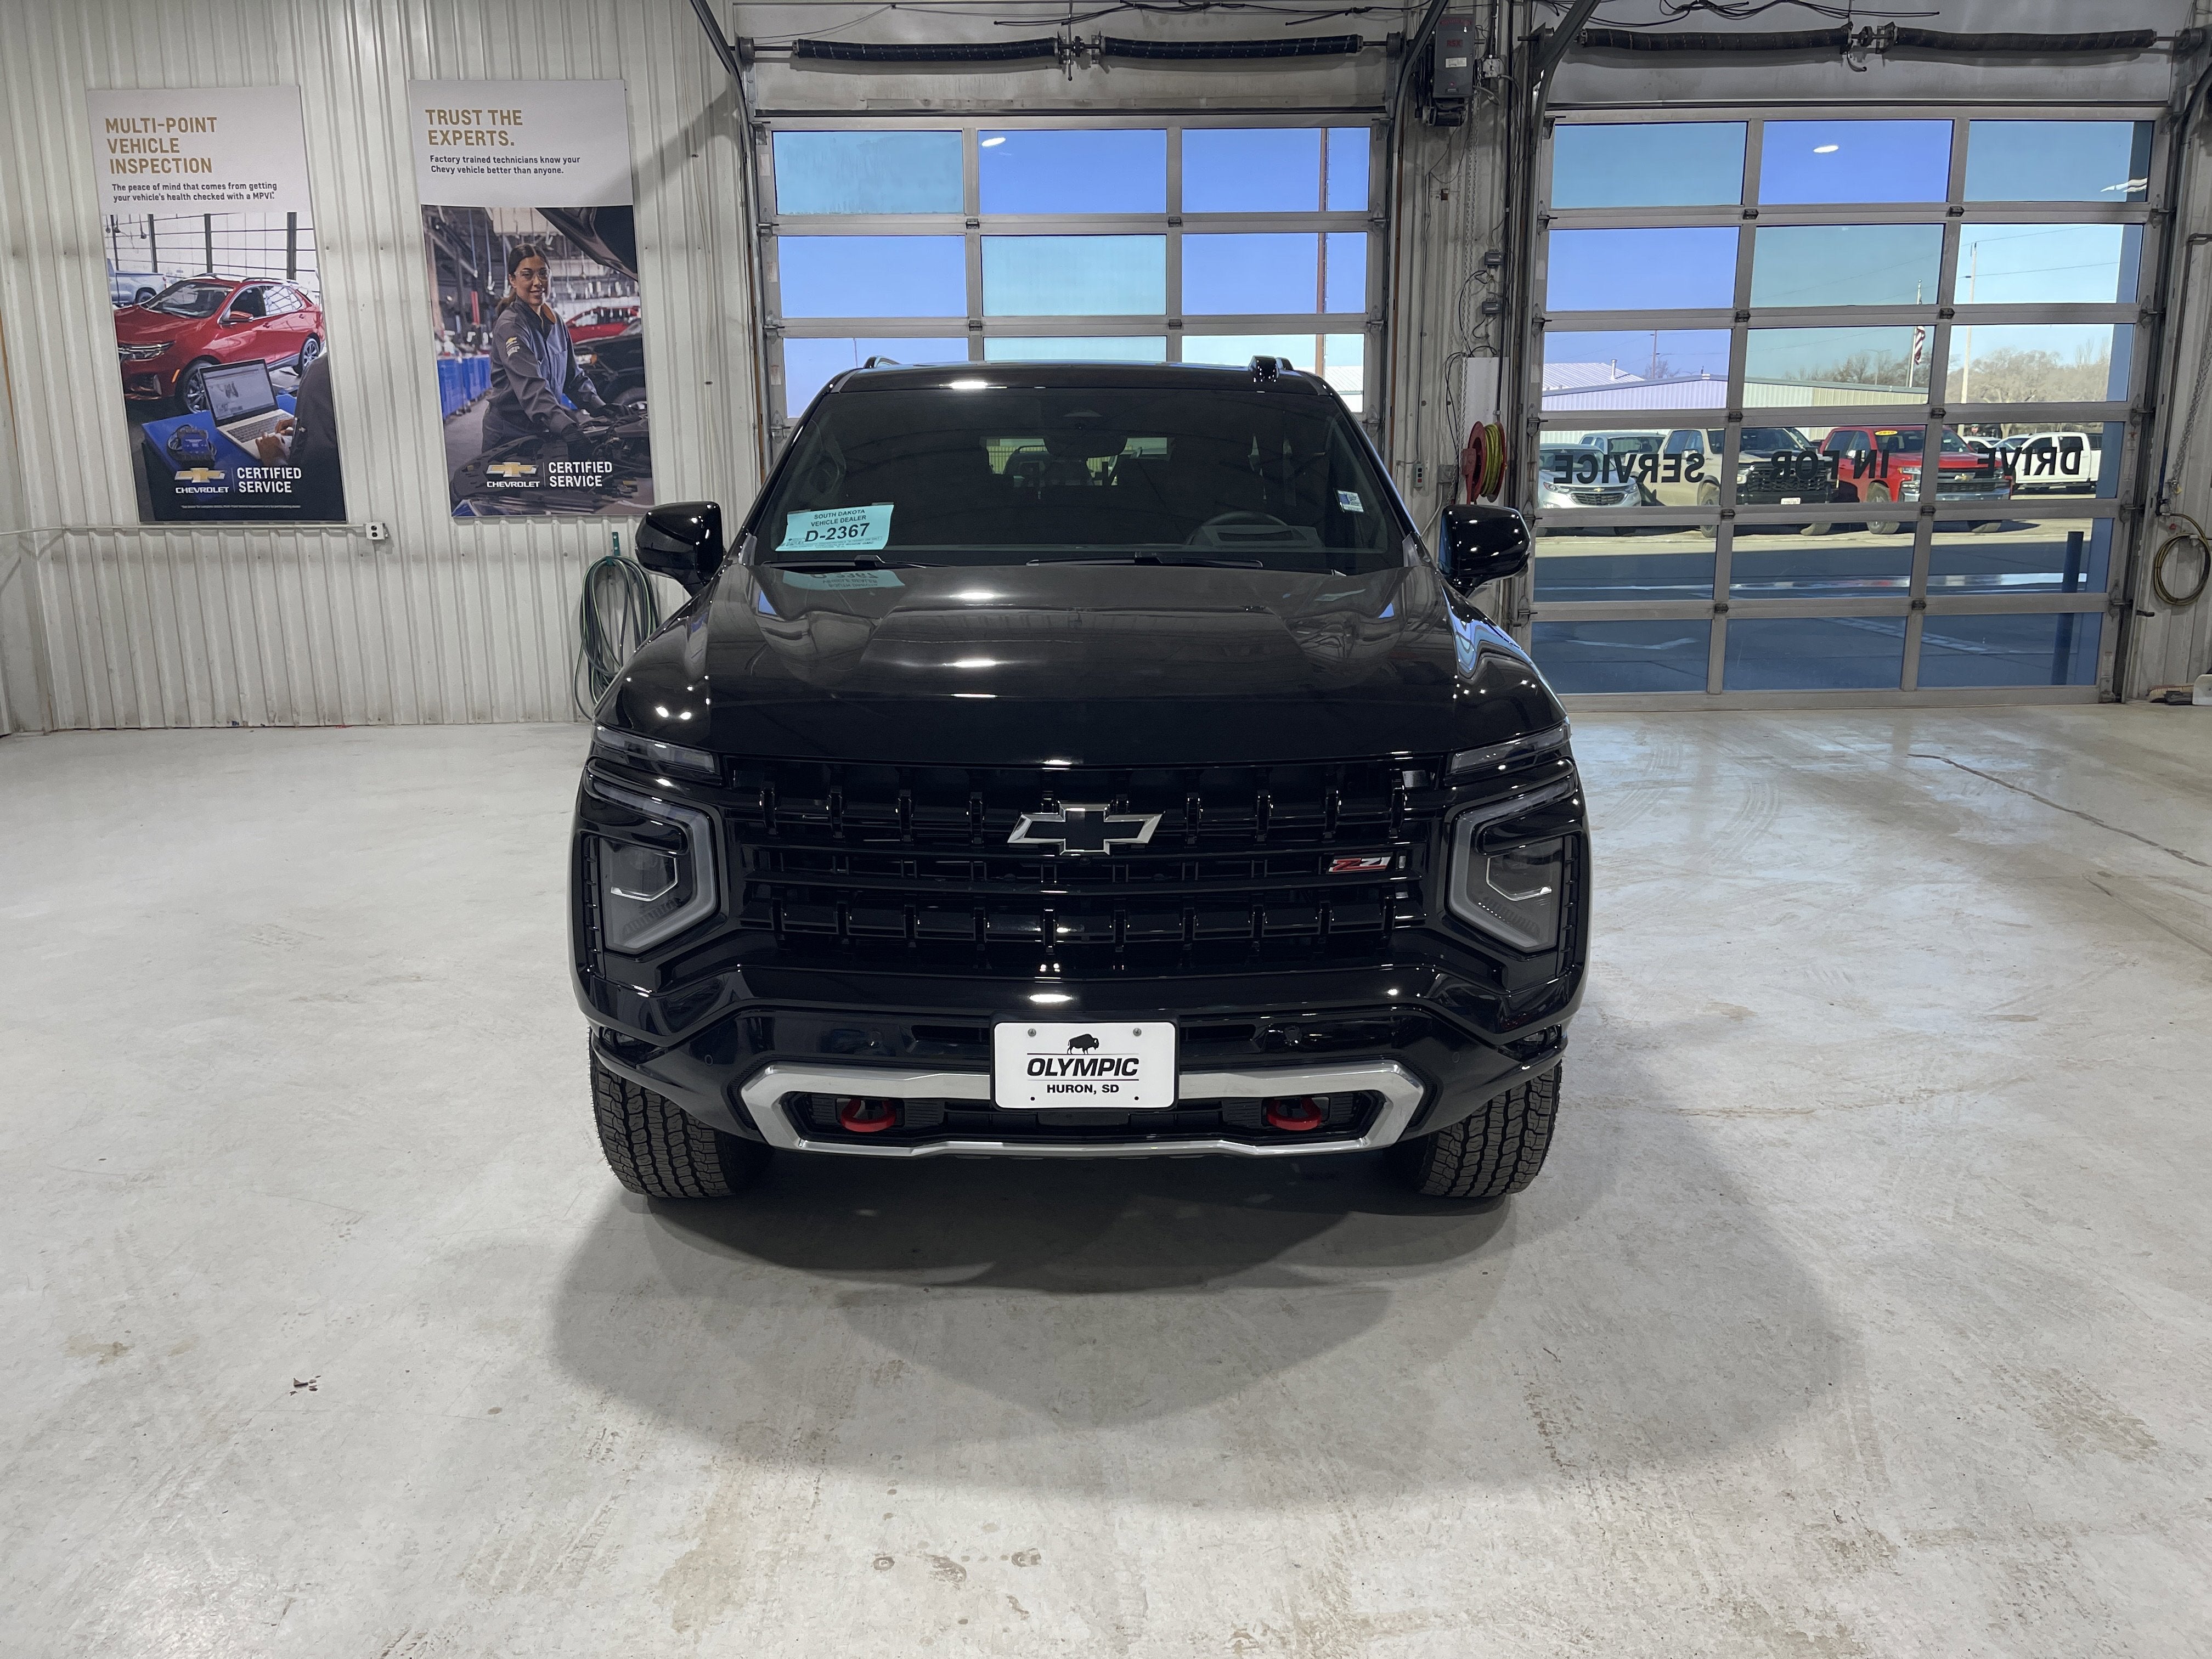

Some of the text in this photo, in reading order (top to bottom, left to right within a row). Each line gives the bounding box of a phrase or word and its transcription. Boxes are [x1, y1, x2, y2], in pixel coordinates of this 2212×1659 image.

[425, 109, 523, 126] TRUST THE
[105, 116, 217, 133] MULTI-POINT
[428, 129, 515, 146] EXPERTS.
[107, 138, 180, 154] VEHICLE
[110, 157, 212, 174] INSPECTION
[430, 155, 460, 165] Factory
[431, 165, 455, 174] Chevy
[249, 182, 277, 191] getting
[113, 195, 131, 204] your
[132, 193, 165, 201] vehicle's
[193, 192, 225, 200] checked
[549, 461, 612, 473] CERTIFIED
[237, 467, 302, 480] CERTIFIED
[238, 481, 292, 493] SERVICE
[549, 475, 602, 487] SERVICE
[175, 486, 229, 494] CHEVROLET
[811, 515, 866, 527] VEHICLE DEALER
[805, 522, 870, 542] D-2367
[1027, 1058, 1139, 1076] OLYMPIC
[1047, 1084, 1119, 1094] HURON, SD
